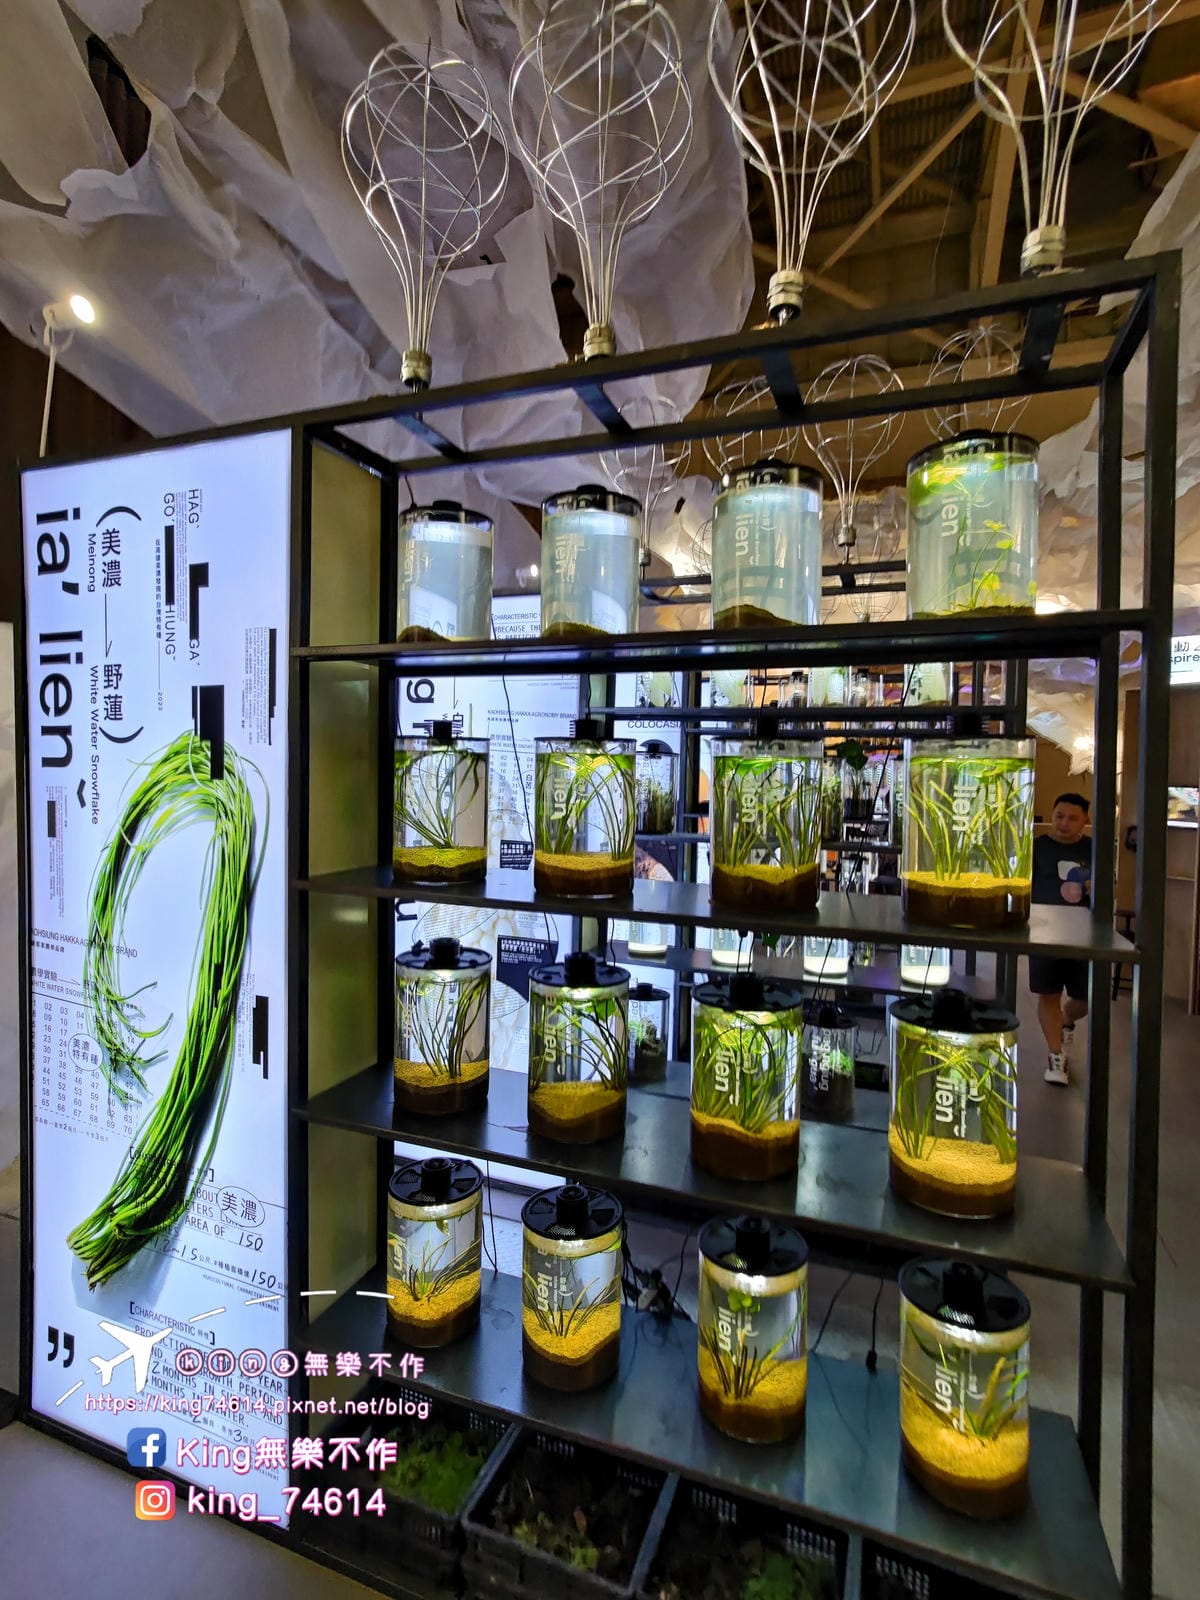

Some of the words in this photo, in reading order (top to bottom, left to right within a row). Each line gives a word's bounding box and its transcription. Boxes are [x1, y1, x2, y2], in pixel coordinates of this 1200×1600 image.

[88, 533, 97, 592] Meinong
[90, 665, 99, 705] White
[90, 709, 99, 750] Water
[91, 755, 100, 825] Snowflake
[44, 1002, 52, 1011] 02
[60, 1007, 68, 1015] 03
[76, 1011, 84, 1019] 04
[44, 1013, 52, 1021] 09
[61, 1018, 68, 1026] 10
[44, 1024, 52, 1032] 16
[60, 1028, 67, 1036] 17
[44, 1034, 52, 1043] 23
[59, 1039, 66, 1048] 24
[43, 1045, 51, 1054] 30
[59, 1050, 66, 1058] 31
[43, 1056, 50, 1064] 37
[59, 1060, 66, 1069] 38
[75, 1065, 82, 1074] 39
[91, 1071, 100, 1080] 40
[58, 1072, 66, 1080] 45
[75, 1076, 82, 1085] 46
[42, 1077, 50, 1086] 51
[58, 1082, 66, 1091] 52
[74, 1087, 82, 1096] 53
[90, 1092, 98, 1102] 59
[42, 1088, 50, 1096] 58
[58, 1093, 66, 1102] 59
[74, 1098, 82, 1106] 60
[90, 1104, 98, 1112] 61
[42, 1098, 50, 1107] 65
[57, 1104, 66, 1112] 66
[74, 1109, 82, 1118] 67
[90, 1114, 98, 1123] 68
[124, 1114, 132, 1124] 63
[107, 1120, 115, 1128] 69
[124, 1126, 132, 1134] 70
[222, 1191, 257, 1223] 美濃
[185, 1215, 209, 1232] AREA
[213, 1224, 225, 1237] OF
[238, 1231, 264, 1251] 150
[151, 1375, 186, 1399] MONTHS
[162, 1366, 197, 1388] MONTHS
[204, 1381, 215, 1396] IN
